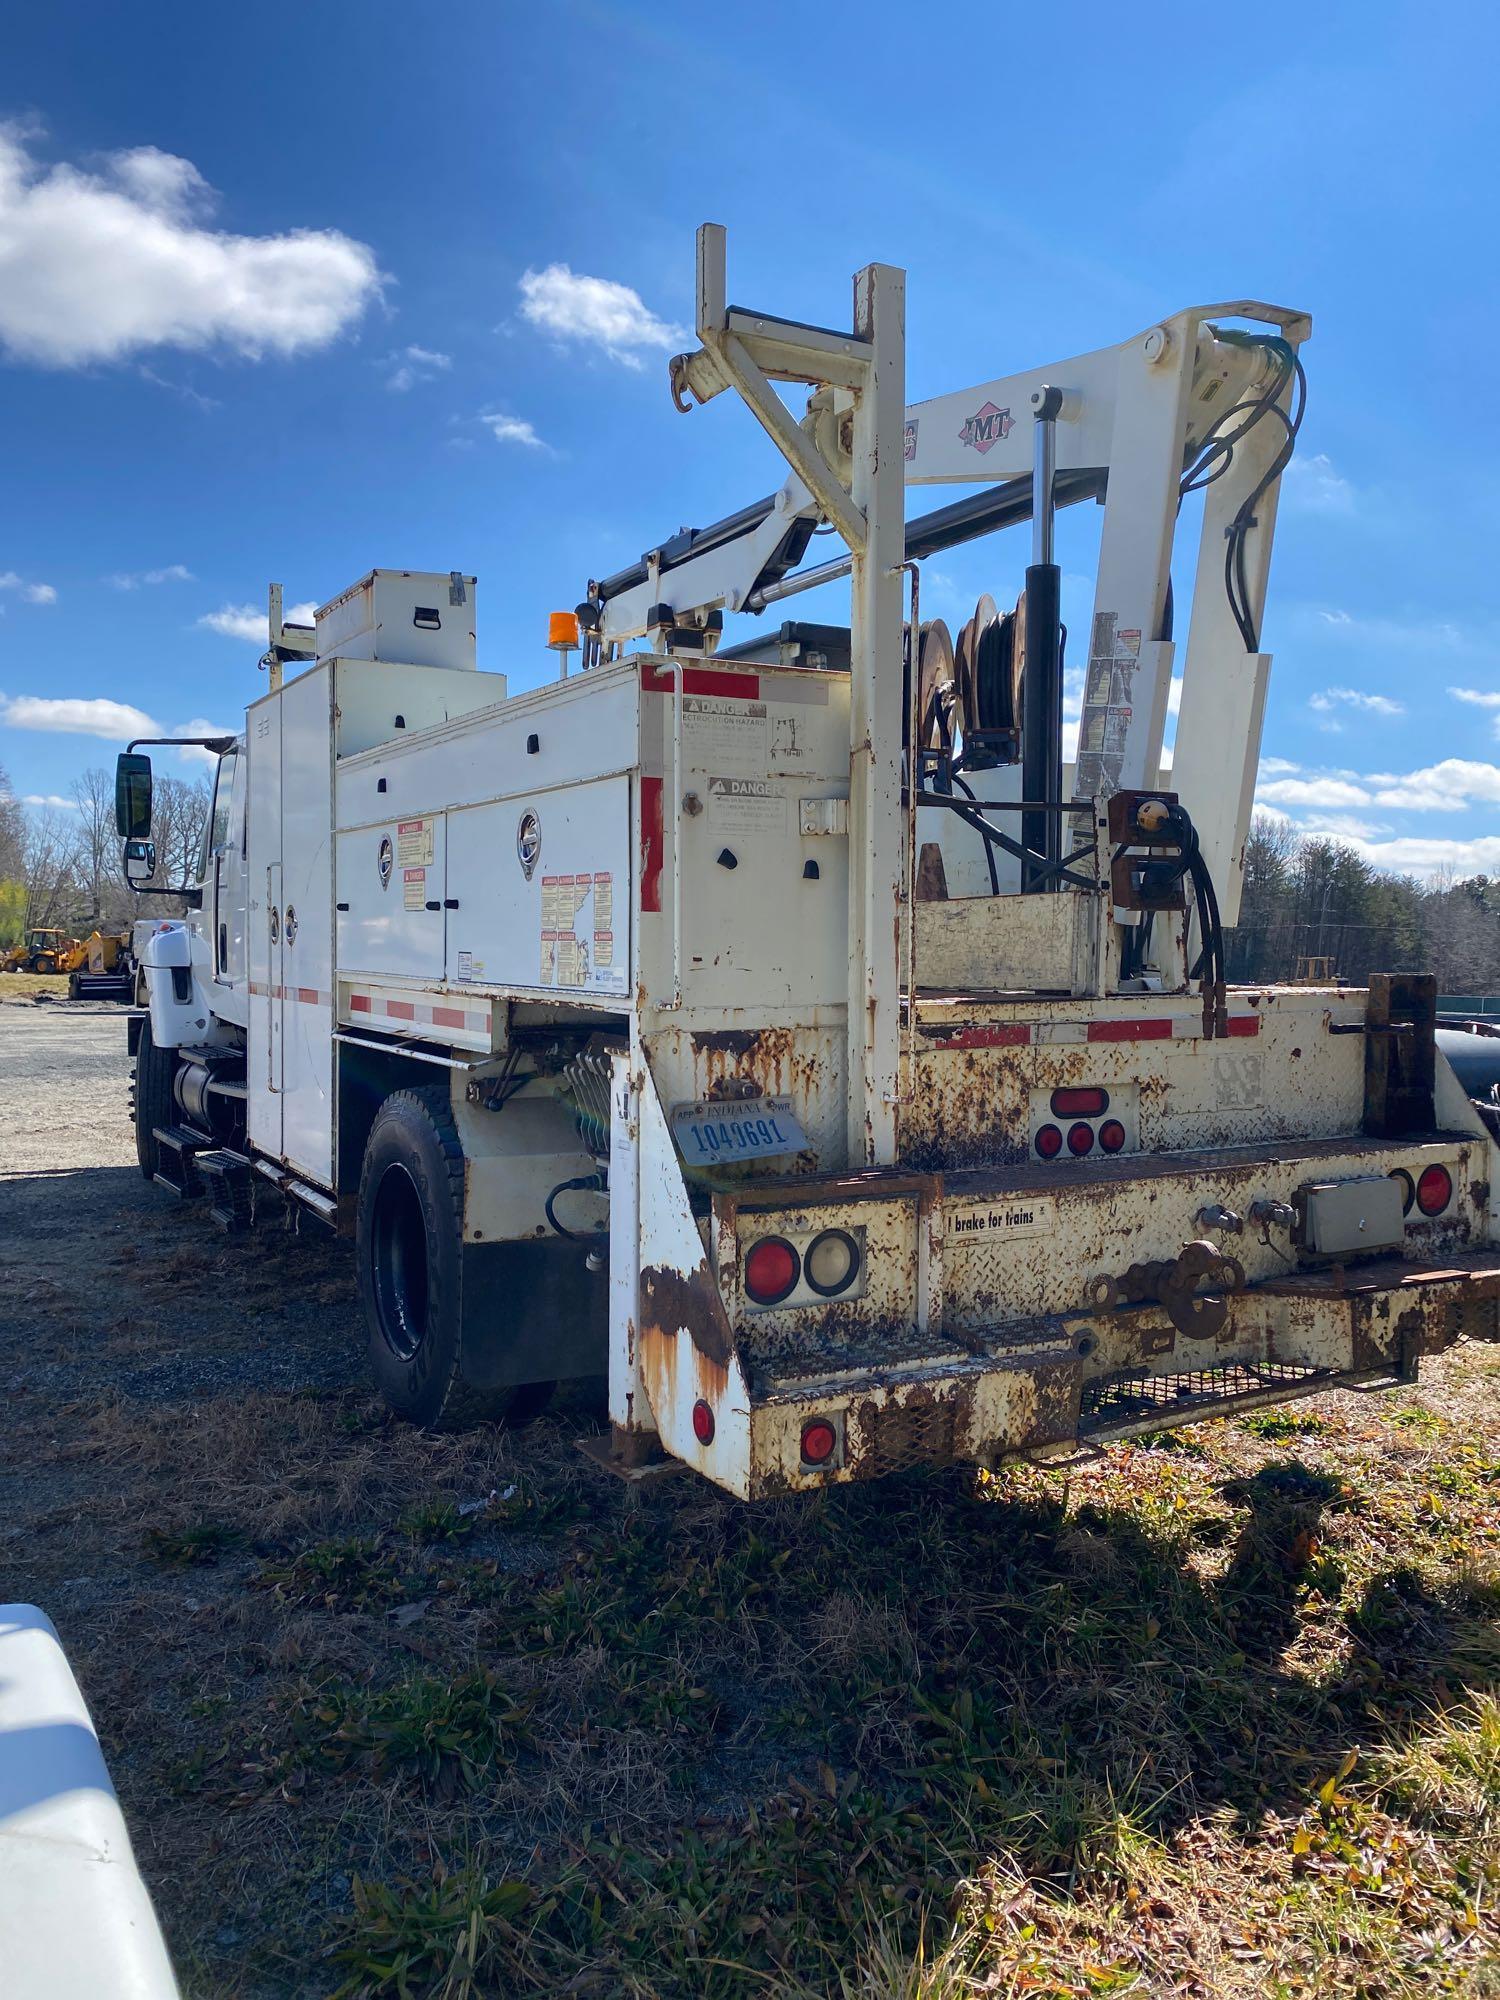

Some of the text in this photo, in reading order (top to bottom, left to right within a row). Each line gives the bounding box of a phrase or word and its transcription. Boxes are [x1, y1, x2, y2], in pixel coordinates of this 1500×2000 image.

[964, 408, 1010, 447] IMT
[701, 701, 750, 716] DANGER
[735, 718, 765, 727] HAZARD
[731, 781, 781, 797] DANGER
[707, 1103, 761, 1117] INDIANA
[948, 1216, 952, 1233] I
[955, 1213, 985, 1232] brake
[988, 1210, 1003, 1228] for
[1005, 1208, 1034, 1226] trains
